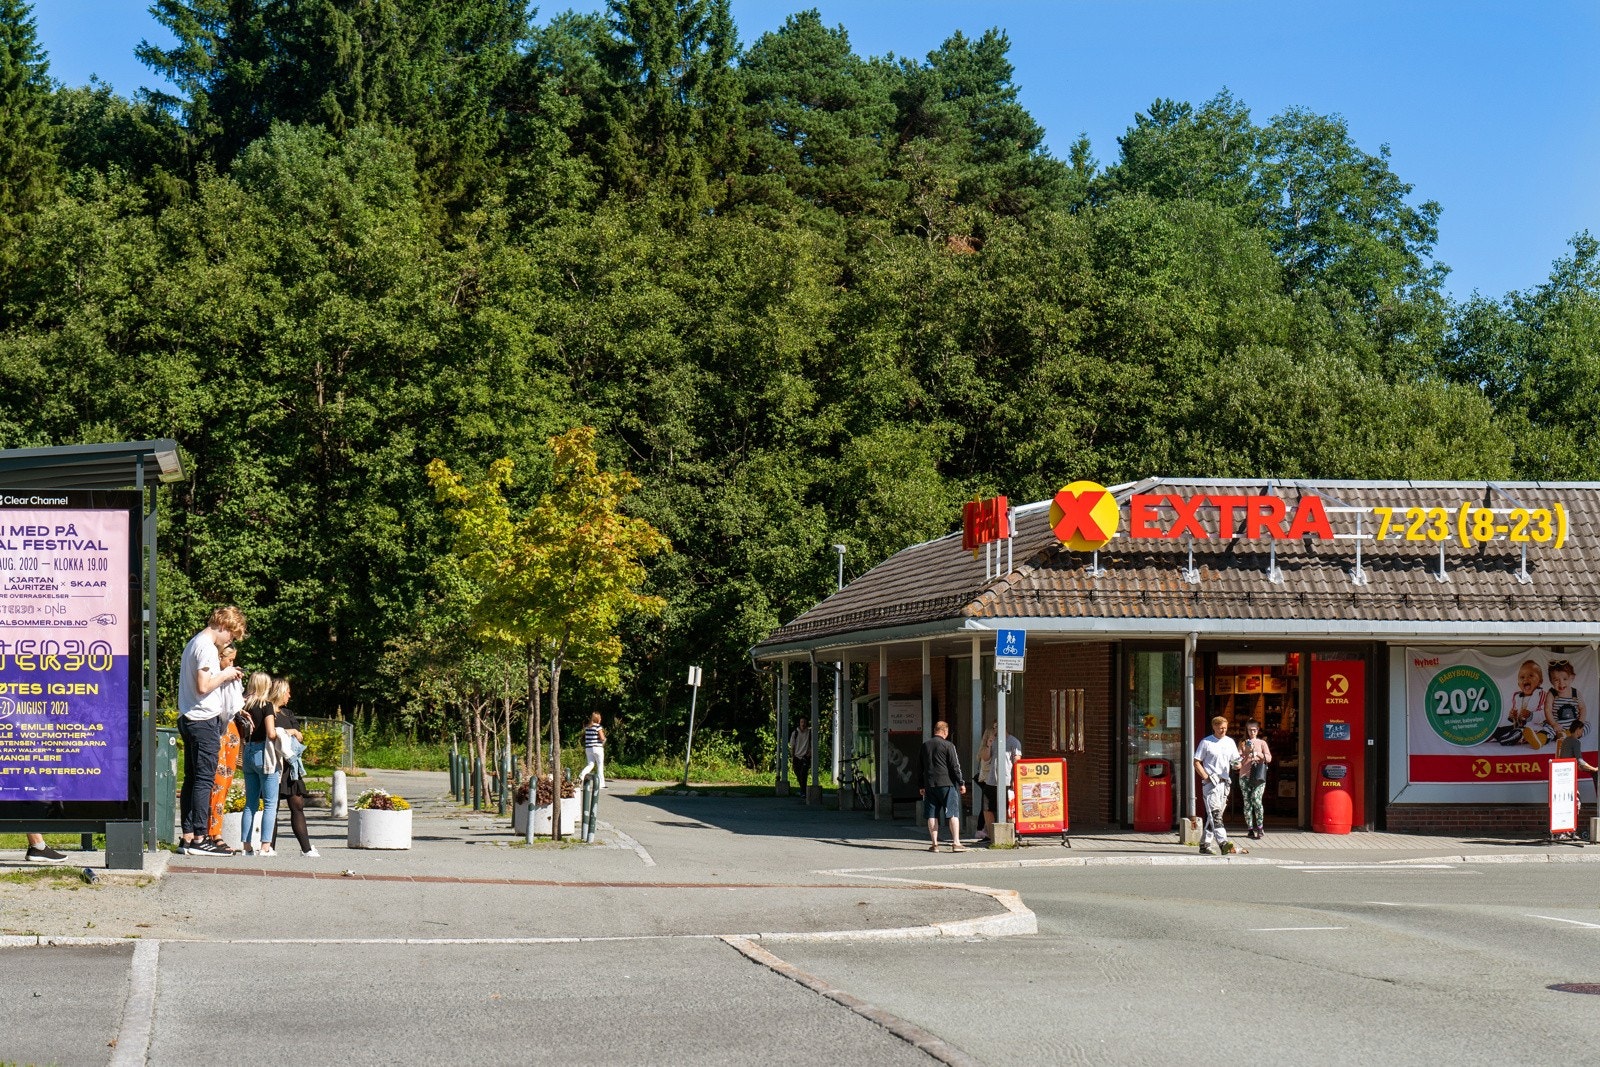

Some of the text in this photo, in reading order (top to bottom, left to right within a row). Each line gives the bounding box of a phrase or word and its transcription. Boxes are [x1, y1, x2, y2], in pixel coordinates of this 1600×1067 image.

[4, 496, 68, 505] Clear Channel
[1130, 494, 1568, 549] EXTRA 7-23 (8-23)
[10, 525, 50, 537] MED
[55, 523, 78, 537] PÅ
[23, 539, 108, 551] FESTIVAL
[19, 557, 38, 571] 2020
[53, 557, 84, 571] KLOKKA
[87, 557, 108, 571] 19.00
[8, 576, 54, 584] KJARTAN
[70, 580, 107, 588] SKAAR
[44, 602, 67, 617] DNB
[1414, 657, 1439, 668] Nyhet!
[1439, 669, 1480, 684] BABYBONUS
[47, 683, 99, 695] IGJEN
[1434, 686, 1490, 715] 20%
[16, 701, 48, 715] AUGUST
[50, 701, 69, 715] 2021
[20, 723, 54, 731] EMILIE
[56, 723, 104, 731] NICOLAS
[32, 754, 62, 762] FLERE
[23, 766, 37, 775] PÅ
[38, 767, 101, 775] PSTEREO.NO
[1020, 765, 1028, 776] 3
[1035, 764, 1050, 776] 99
[1495, 762, 1542, 774] EXTRA
